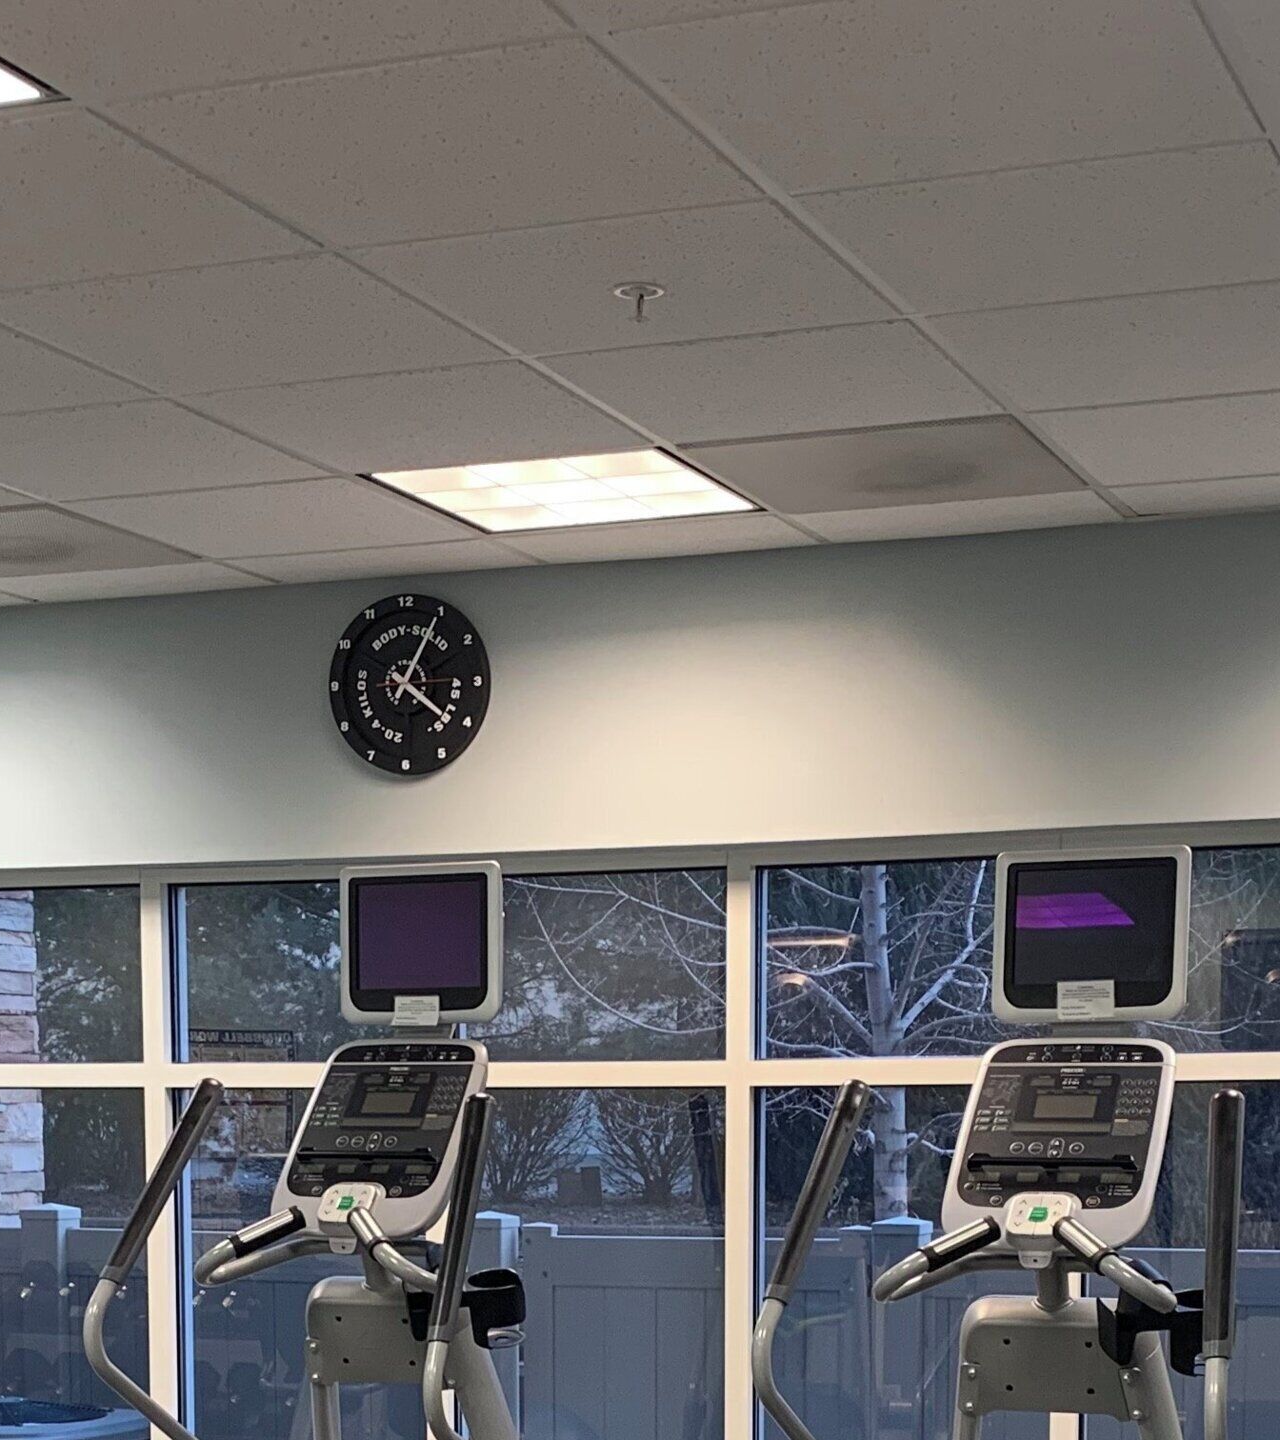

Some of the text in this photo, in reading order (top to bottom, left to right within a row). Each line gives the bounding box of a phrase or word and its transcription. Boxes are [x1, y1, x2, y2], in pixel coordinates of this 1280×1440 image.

[397, 596, 414, 607] 12
[364, 609, 375, 619] 11
[437, 606, 444, 616] 1
[338, 639, 351, 650] 10
[463, 634, 473, 645] 2
[330, 681, 339, 691] 9
[473, 675, 483, 686] 3
[356, 669, 374, 719] KILOS
[450, 677, 462, 700] 45
[340, 721, 349, 732] 8
[462, 716, 472, 728] 4
[367, 750, 375, 761] 7
[437, 748, 446, 759] 5
[401, 759, 410, 770] 6
